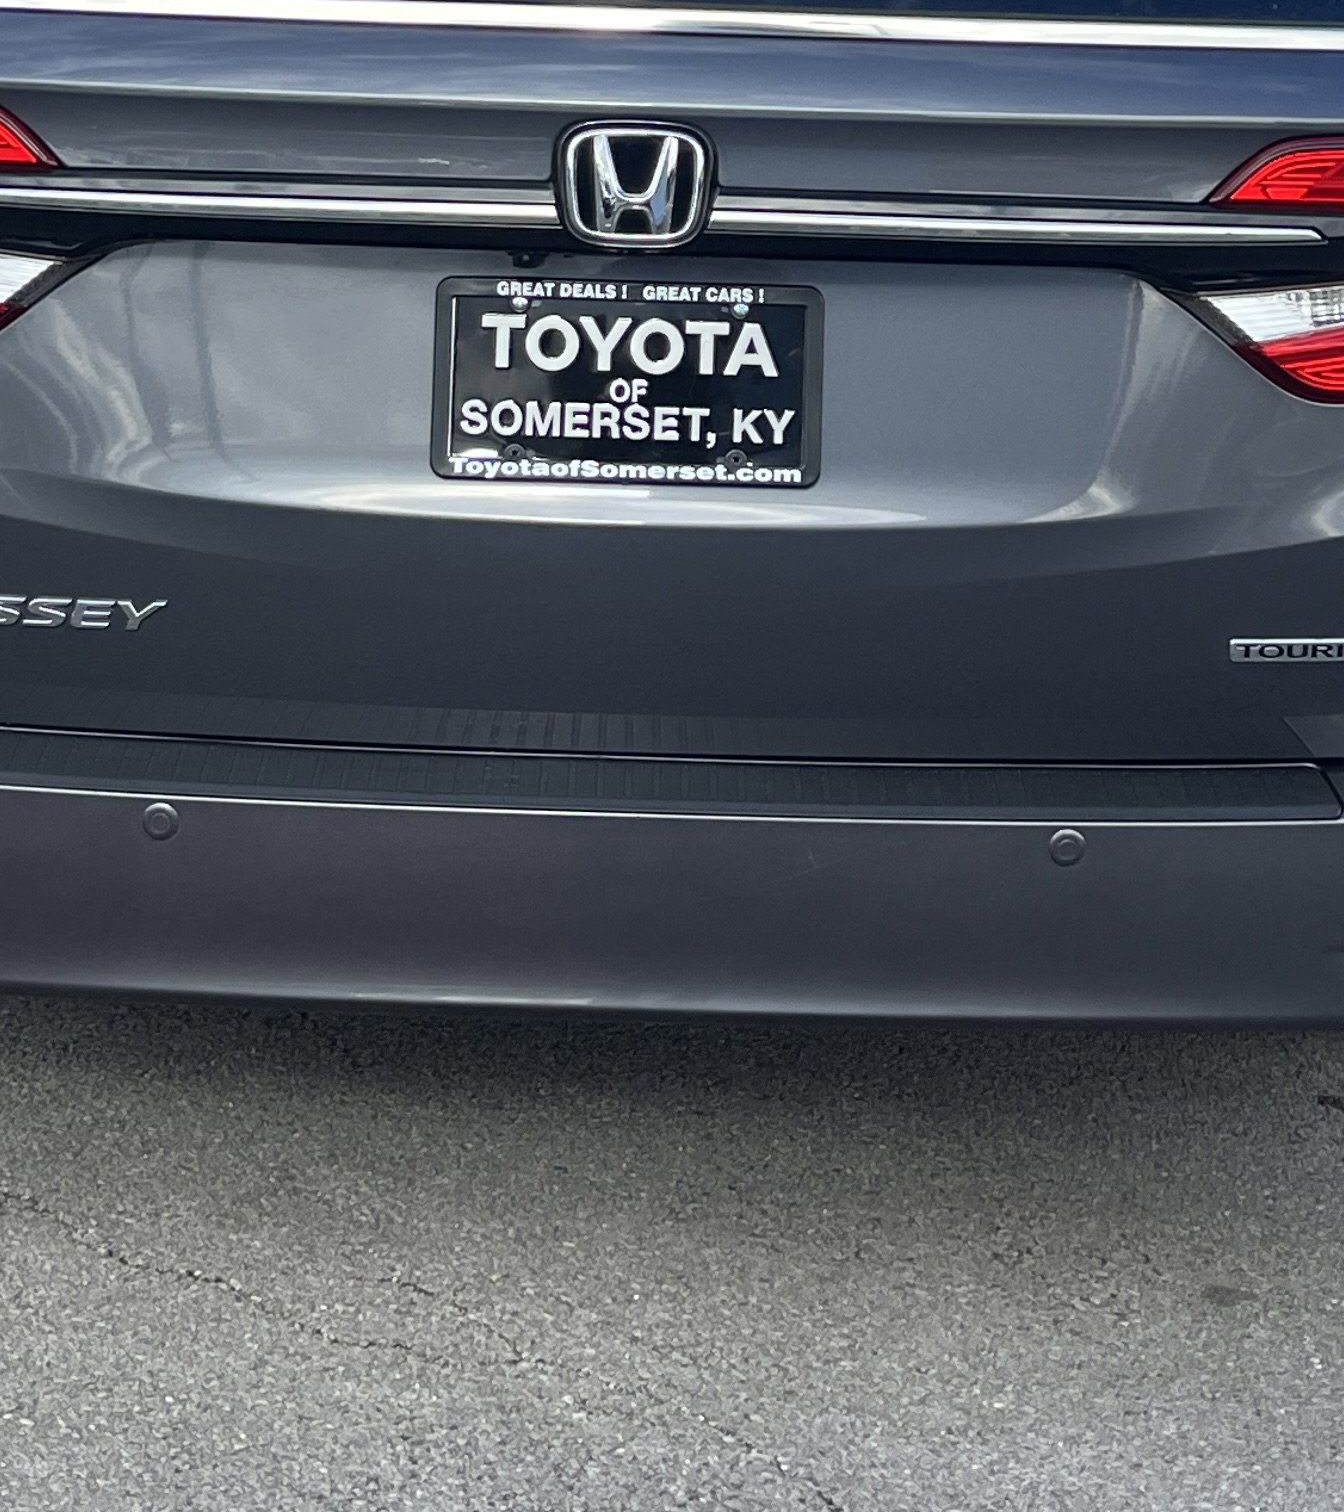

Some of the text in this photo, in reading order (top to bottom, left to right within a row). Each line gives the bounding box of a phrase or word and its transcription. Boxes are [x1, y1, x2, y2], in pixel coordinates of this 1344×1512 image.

[497, 281, 555, 297] GREAT
[642, 285, 701, 302] GREAT
[481, 312, 779, 378] TOYOTA
[610, 377, 649, 403] OF
[460, 399, 795, 449] SOMERSET, KY
[449, 456, 802, 483] ToyotaofSomerset.com
